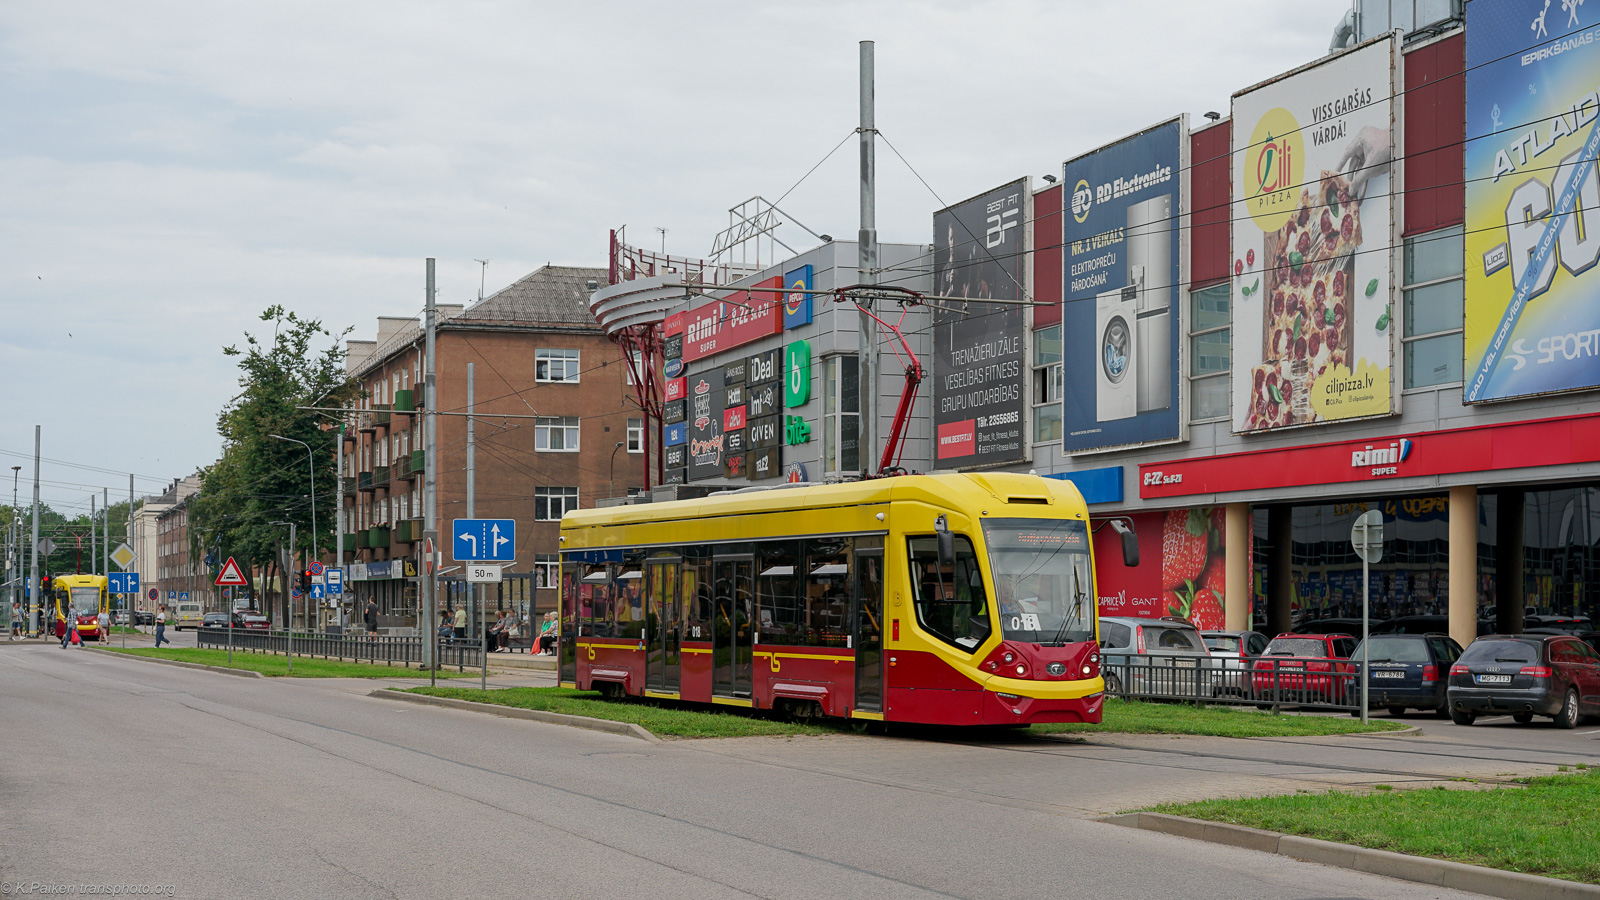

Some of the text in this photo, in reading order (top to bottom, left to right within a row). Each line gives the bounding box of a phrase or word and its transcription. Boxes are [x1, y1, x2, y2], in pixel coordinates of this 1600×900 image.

[1521, 31, 1594, 67] IEPIRKŠANĀS
[1312, 87, 1372, 122] VISS GARŠAS
[1312, 120, 1347, 147] VĀRDĀ!
[1493, 86, 1600, 183] ATLAID
[1097, 181, 1112, 205] RD
[1113, 163, 1171, 199] Electronics
[987, 193, 1019, 214] BEST FIT
[1259, 190, 1292, 208] PIZZA
[986, 207, 1019, 249] BF
[1071, 226, 1124, 257] NR. 1 VEIKALS
[1535, 216, 1562, 263] TAGAD
[1071, 252, 1117, 277] ELEKTROPREČU
[731, 303, 749, 328] 8-22
[1494, 281, 1530, 351] IZDEVĪGĀK
[699, 339, 717, 353] SUPER
[951, 336, 1019, 367] TRENAŽIERU ZĀLE
[751, 352, 774, 382] iDeal
[791, 351, 801, 395] b
[944, 360, 1019, 391] VESELĪBAS FITNESS
[941, 383, 1019, 413] GRUPU NODARBĪBAS
[1325, 372, 1374, 397] cilipizza.lv
[751, 423, 774, 443] GIVEN
[690, 434, 724, 466] Orange
[756, 455, 769, 472] TELE2
[1143, 471, 1163, 486] 8-22
[1371, 466, 1397, 476] SUPER
[474, 569, 485, 578] 50
[1097, 595, 1159, 607] CAPRICE GANT
[692, 625, 701, 638] 018
